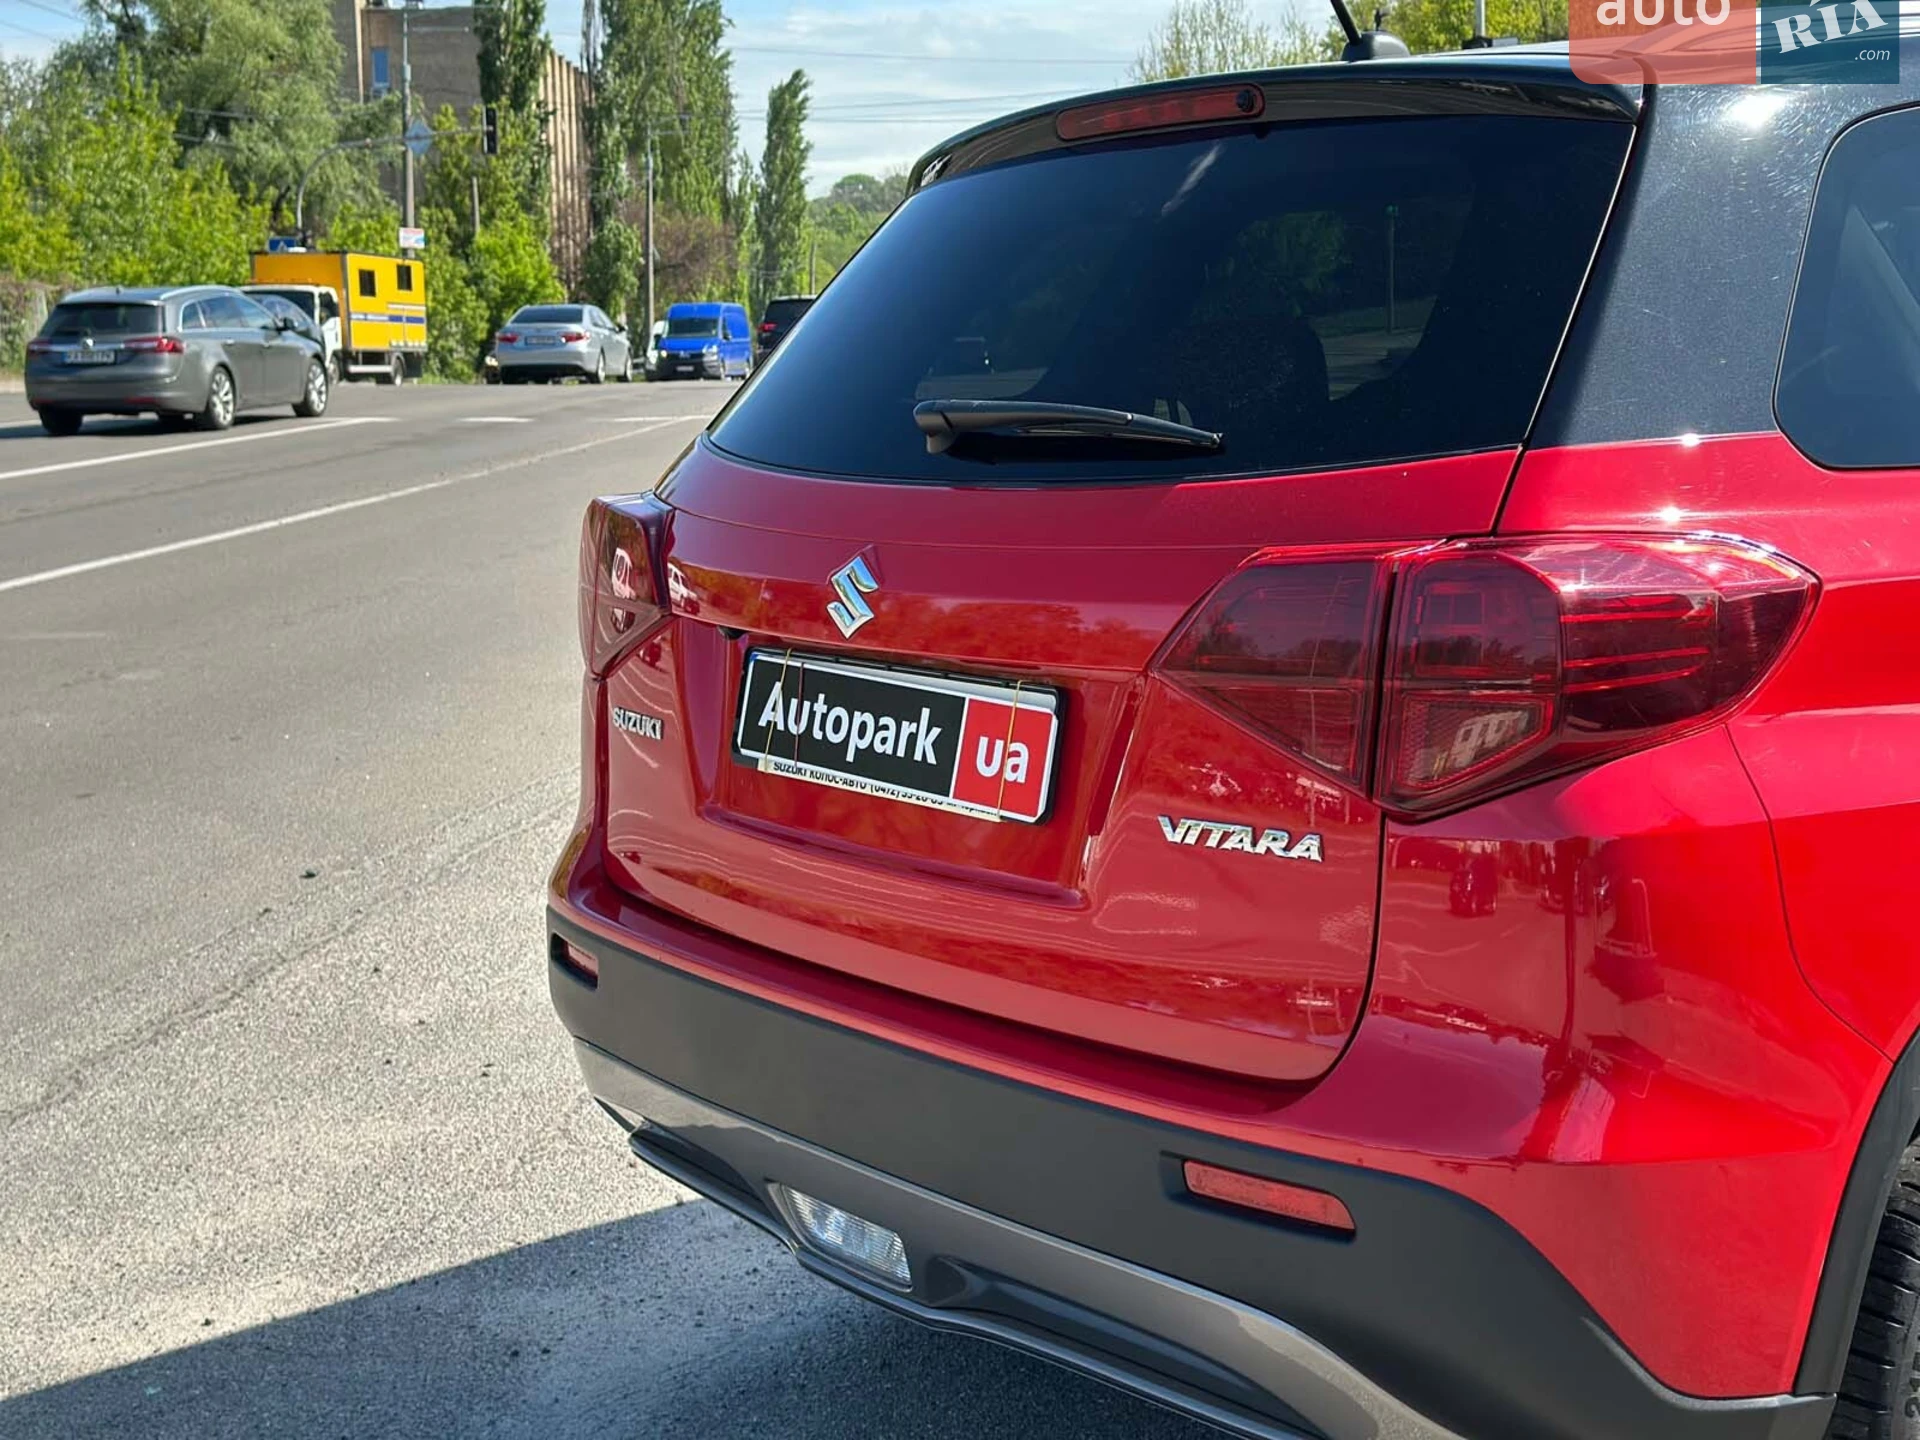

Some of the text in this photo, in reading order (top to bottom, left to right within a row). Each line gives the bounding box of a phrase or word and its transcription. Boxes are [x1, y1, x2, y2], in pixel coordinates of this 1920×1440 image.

[612, 707, 662, 740] SUZUKI
[758, 681, 1030, 784] Autopark ua
[1157, 815, 1323, 863] VITARA
